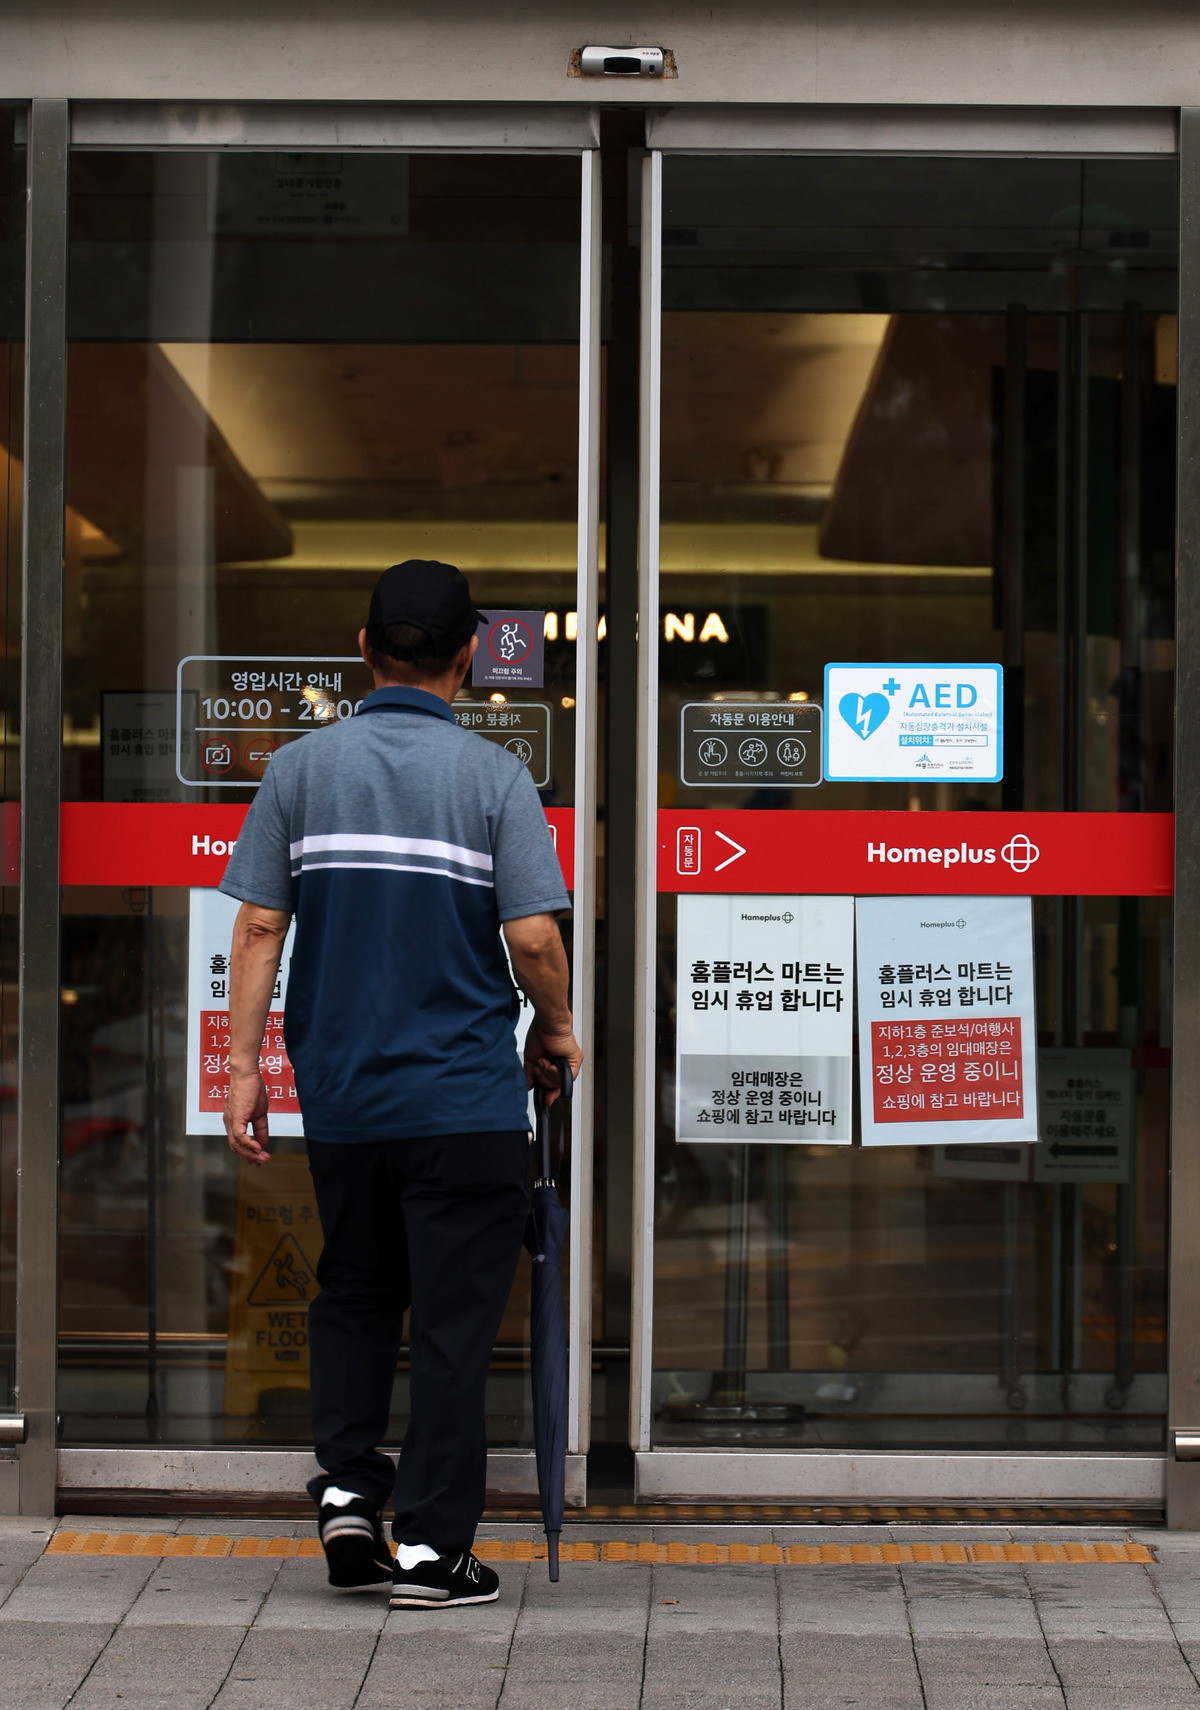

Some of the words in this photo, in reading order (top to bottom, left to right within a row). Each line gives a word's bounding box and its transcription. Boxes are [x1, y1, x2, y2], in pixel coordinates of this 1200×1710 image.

[492, 667, 510, 675] 미끄럼
[511, 667, 523, 675] 주의
[231, 672, 302, 692] 영업시간
[308, 672, 342, 692] 안내
[909, 684, 977, 708] AED
[202, 698, 272, 720] 10:00
[710, 714, 745, 726] 자동문
[749, 714, 794, 726] 이용안내
[900, 722, 954, 731] 자동심장충격기
[957, 723, 987, 731] 설치시설
[901, 736, 932, 745] 설치위치:
[682, 835, 694, 869] 자동문
[867, 843, 996, 867] Homeplus
[741, 913, 781, 923] Homeplus
[920, 920, 955, 930] Homeplus
[690, 960, 774, 985] 홈플러스
[781, 960, 845, 985] 마트는
[878, 964, 952, 985] 홈플러스
[958, 962, 1013, 981] 마트는
[691, 989, 729, 1012] 임시
[735, 990, 773, 1012] 휴업
[780, 990, 844, 1013] 합니다
[880, 988, 913, 1009] 임시
[919, 988, 952, 1008] 휴업
[958, 985, 1013, 1006] 합니다
[878, 1024, 927, 1040] 지하1층
[930, 1021, 1014, 1039] 준보석/여행사
[882, 1043, 943, 1058] 1,2,3층의
[946, 1041, 1011, 1057] 임대매장은
[731, 1071, 803, 1087] 임대매장은
[876, 1063, 913, 1085] 정상
[920, 1062, 957, 1083] 운영
[963, 1060, 1018, 1081] 중이니
[711, 1090, 741, 1107] 정상
[745, 1090, 775, 1107] 운영
[778, 1090, 821, 1107] 중이니
[881, 1093, 925, 1110] 쇼핑에
[930, 1093, 958, 1107] 참고
[963, 1091, 1021, 1107] 바랍니다
[696, 1109, 741, 1125] 쇼핑에
[745, 1109, 774, 1125] 참고
[778, 1109, 836, 1126] 바랍니다
[1060, 1110, 1106, 1122] 자동문을
[247, 1205, 293, 1225] 미끄럼
[268, 1312, 308, 1328] WET
[256, 1330, 307, 1347] FLOO
